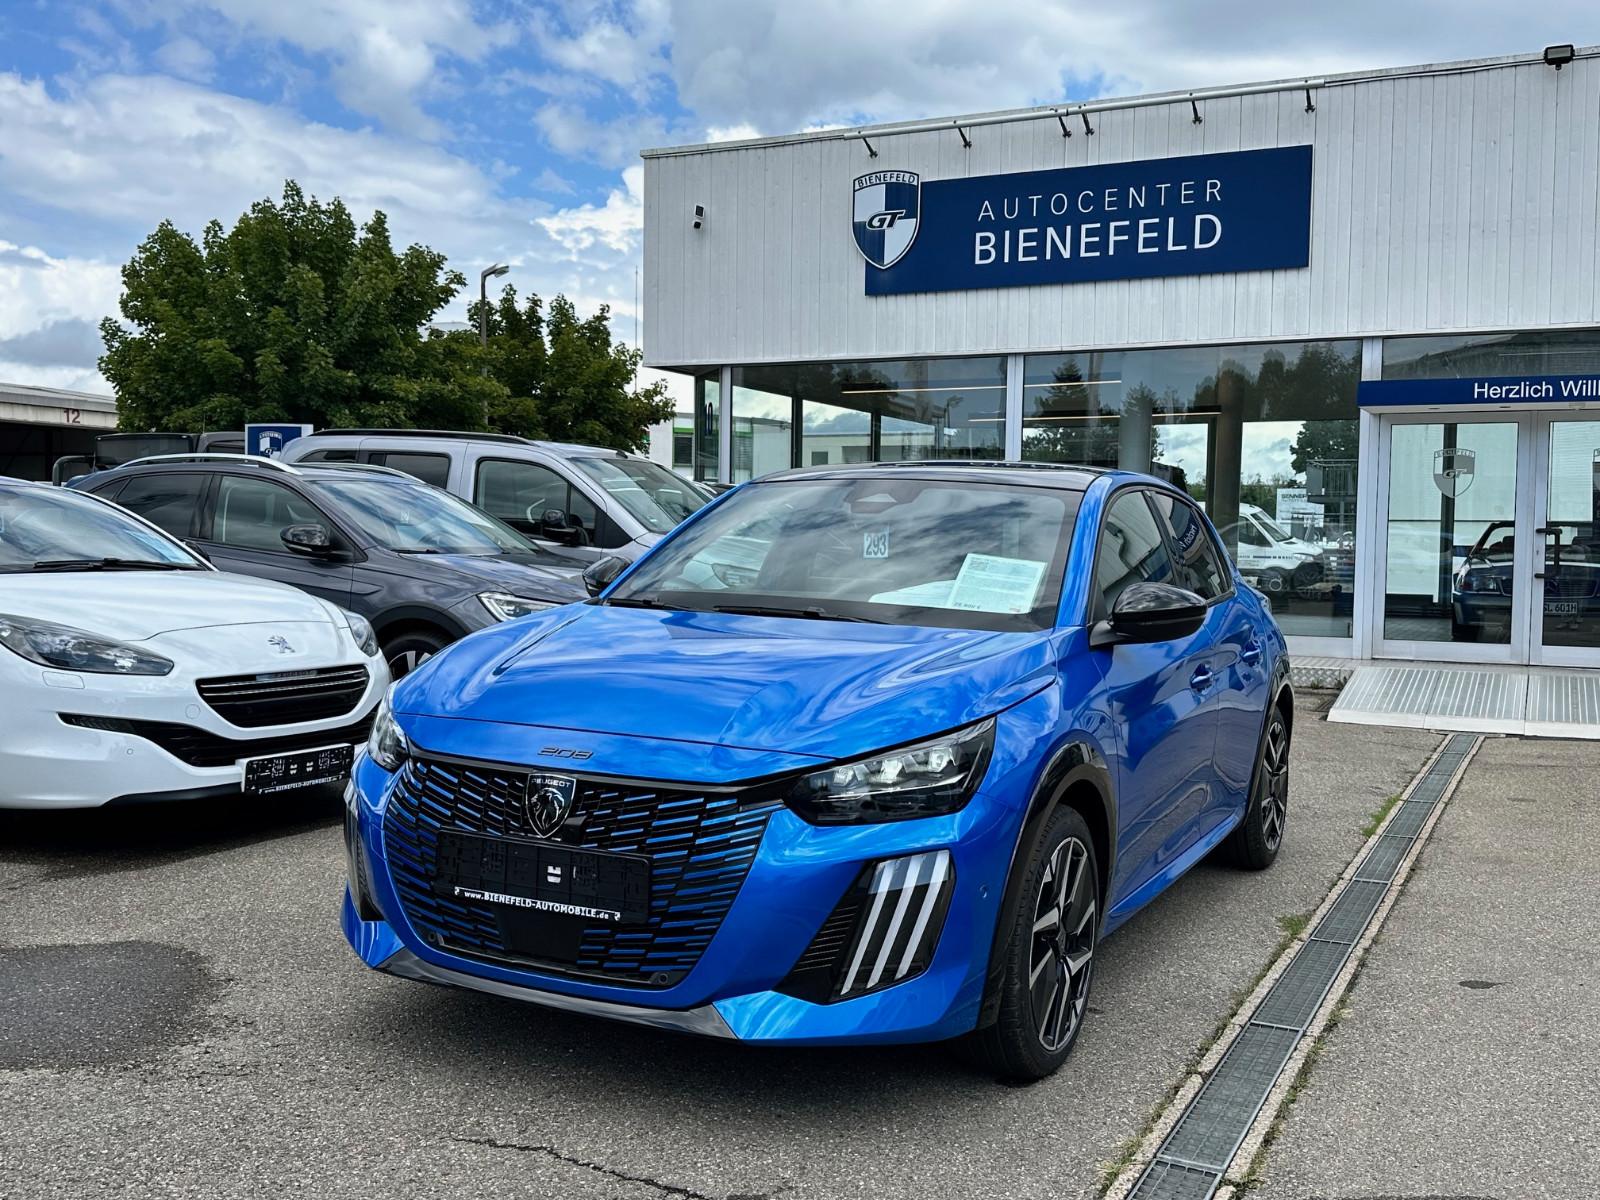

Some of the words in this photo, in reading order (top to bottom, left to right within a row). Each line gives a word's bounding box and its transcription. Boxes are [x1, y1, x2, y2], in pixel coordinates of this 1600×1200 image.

[857, 172, 916, 188] BIENEFELD
[978, 179, 1222, 222] AUTOCENTER
[866, 209, 906, 230] GT
[974, 213, 1223, 265] BIENEFELD
[1474, 381, 1553, 399] Herzlich
[1560, 379, 1600, 397] Will
[64, 408, 80, 424] 12
[866, 534, 887, 556] 293
[537, 746, 594, 760] 208
[532, 778, 571, 788] PEUGEOT
[464, 890, 609, 920] www.BIENEFELD-AUTOMOBILE.de
